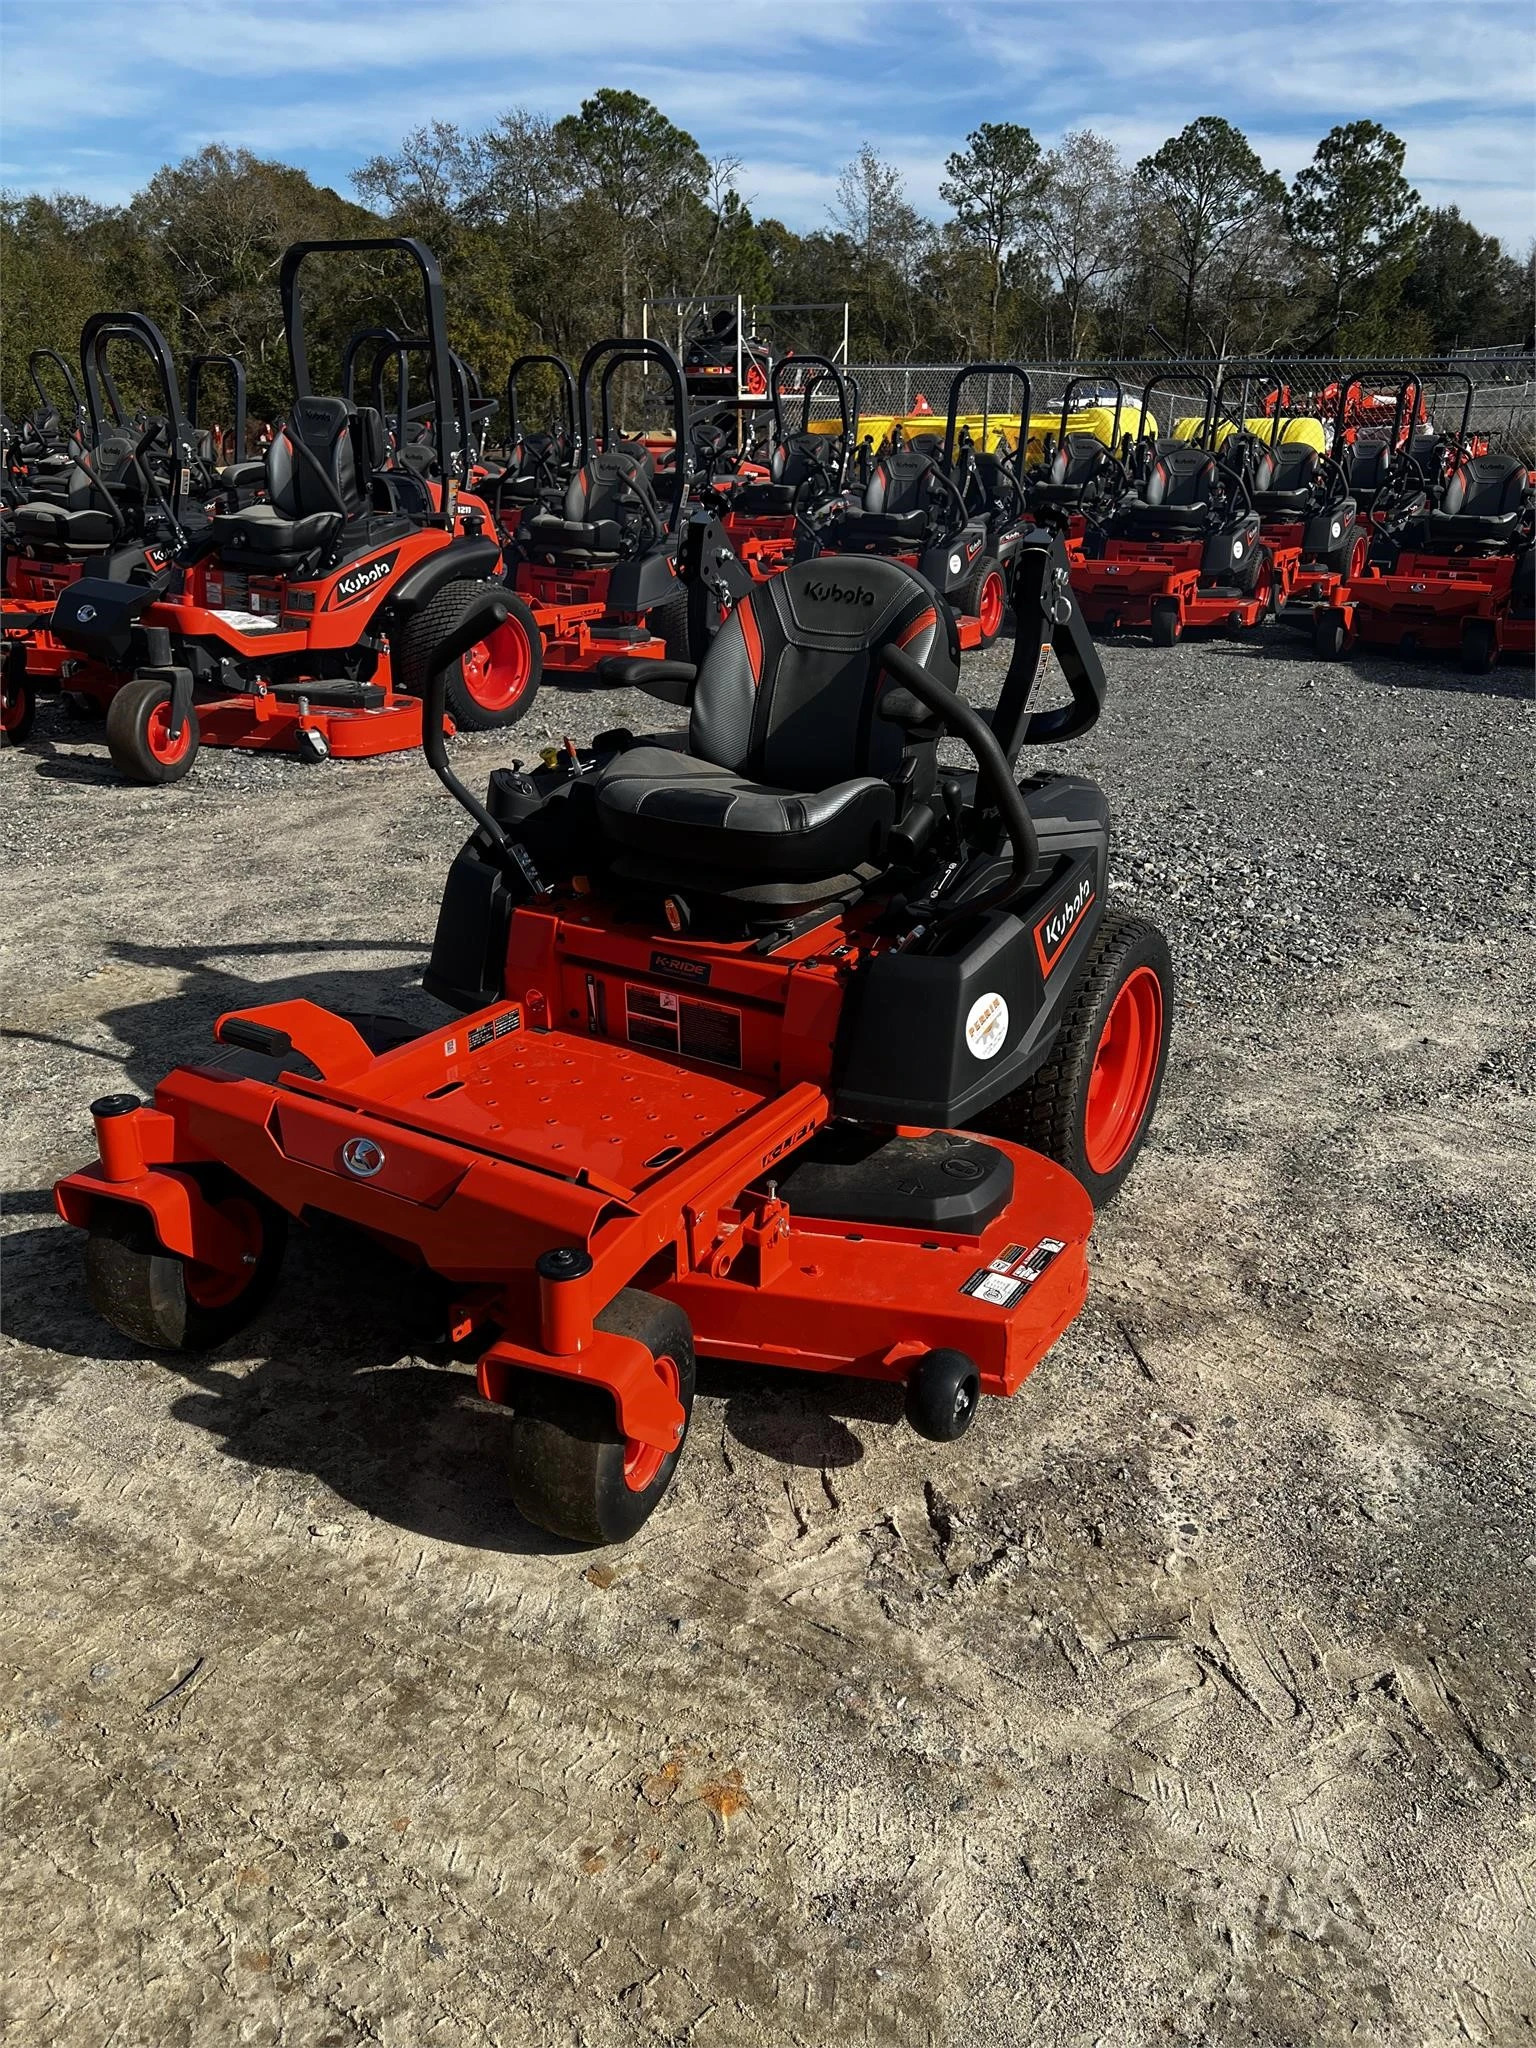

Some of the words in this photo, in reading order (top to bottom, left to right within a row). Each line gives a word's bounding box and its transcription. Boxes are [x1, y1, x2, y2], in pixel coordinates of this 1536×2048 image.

[153, 544, 182, 561] Kubot
[339, 563, 390, 594] Kubota
[804, 582, 874, 605] Kubota
[1046, 880, 1090, 944] Kubota
[655, 956, 705, 975] K-RIDE
[762, 1118, 816, 1168] K-LIFT
